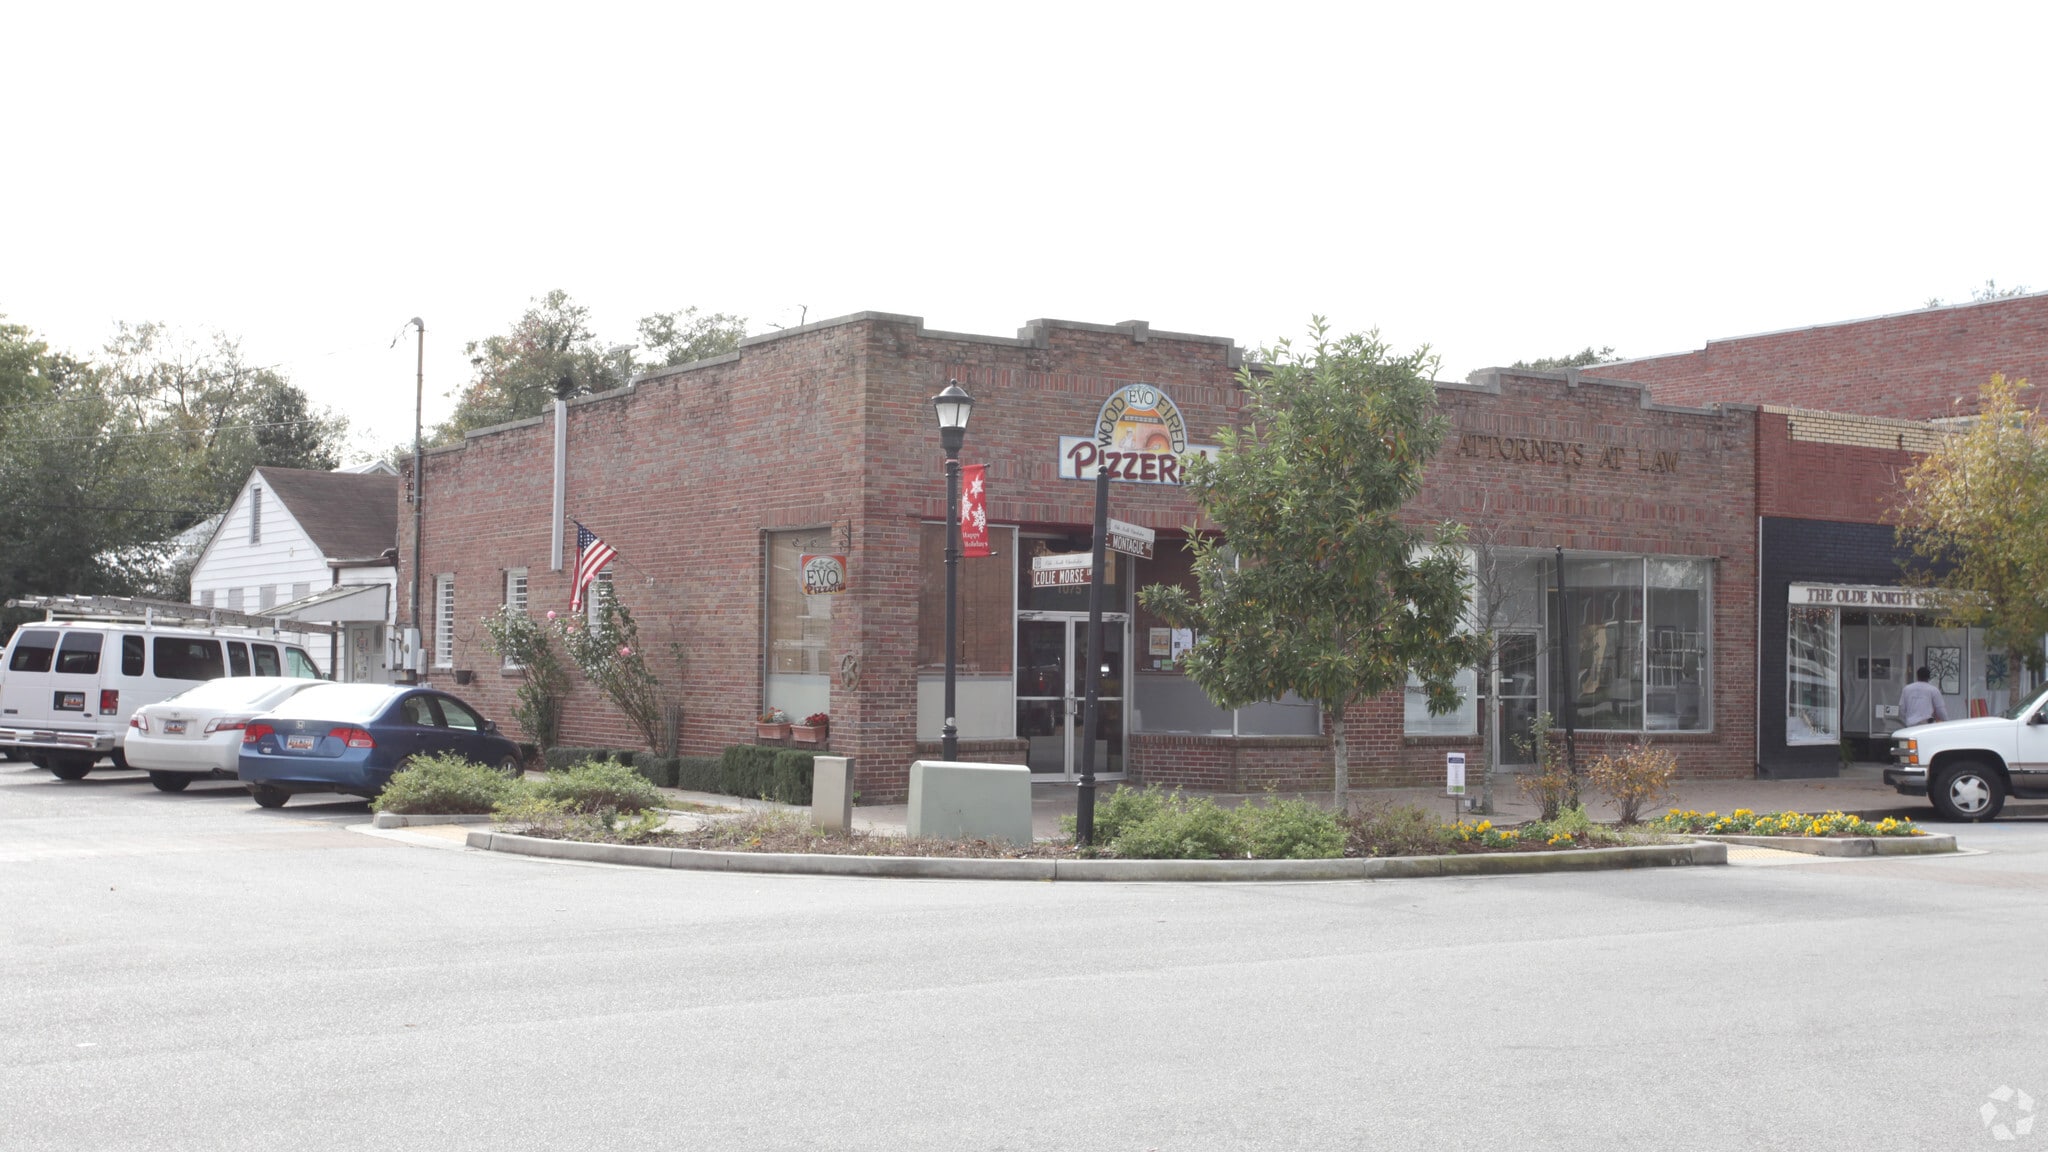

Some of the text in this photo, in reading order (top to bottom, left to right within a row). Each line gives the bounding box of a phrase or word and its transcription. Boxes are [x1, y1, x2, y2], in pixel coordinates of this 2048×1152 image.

[1128, 391, 1154, 405] EVO
[1098, 396, 1186, 454] WOOD FIRED
[1455, 433, 1679, 473] ATTORNEYS AT LAW
[1067, 441, 1209, 484] PIZZERI
[963, 532, 980, 540] Happy
[1112, 535, 1145, 555] MONTAGUE
[806, 569, 838, 586] EVO
[1035, 570, 1056, 585] COLIE
[1059, 568, 1084, 583] MORSE
[1807, 588, 1833, 602] THE
[1836, 589, 1867, 603] OLDE
[1871, 591, 1912, 606] NORTH
